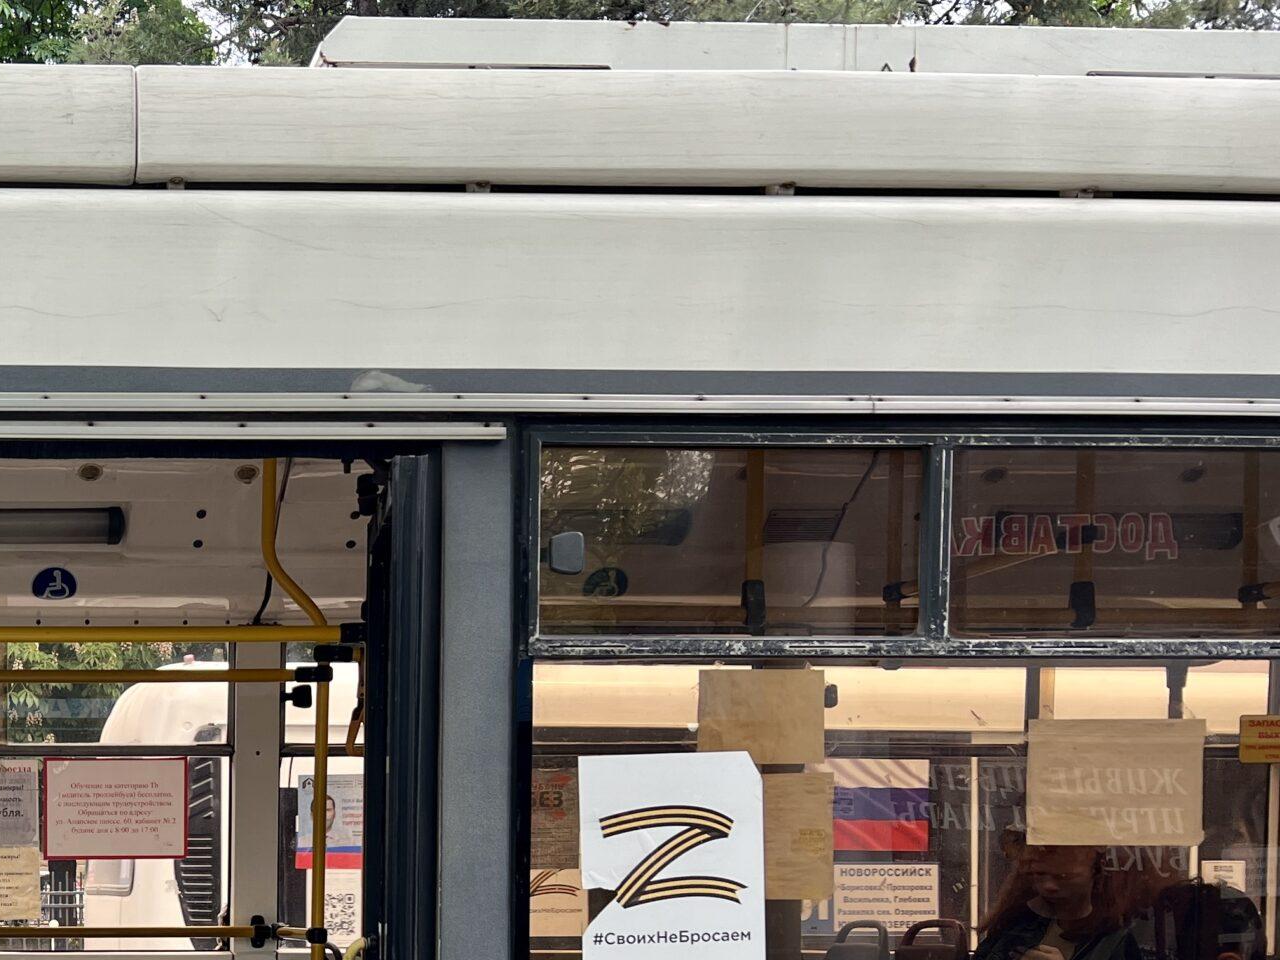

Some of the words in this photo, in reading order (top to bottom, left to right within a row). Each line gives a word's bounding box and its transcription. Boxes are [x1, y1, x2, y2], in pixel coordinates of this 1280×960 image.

[839, 867, 932, 877] НОВОРОССИЙСК
[893, 895, 931, 904] Глебовка
[592, 930, 752, 946] #СвоихНеБросаем
